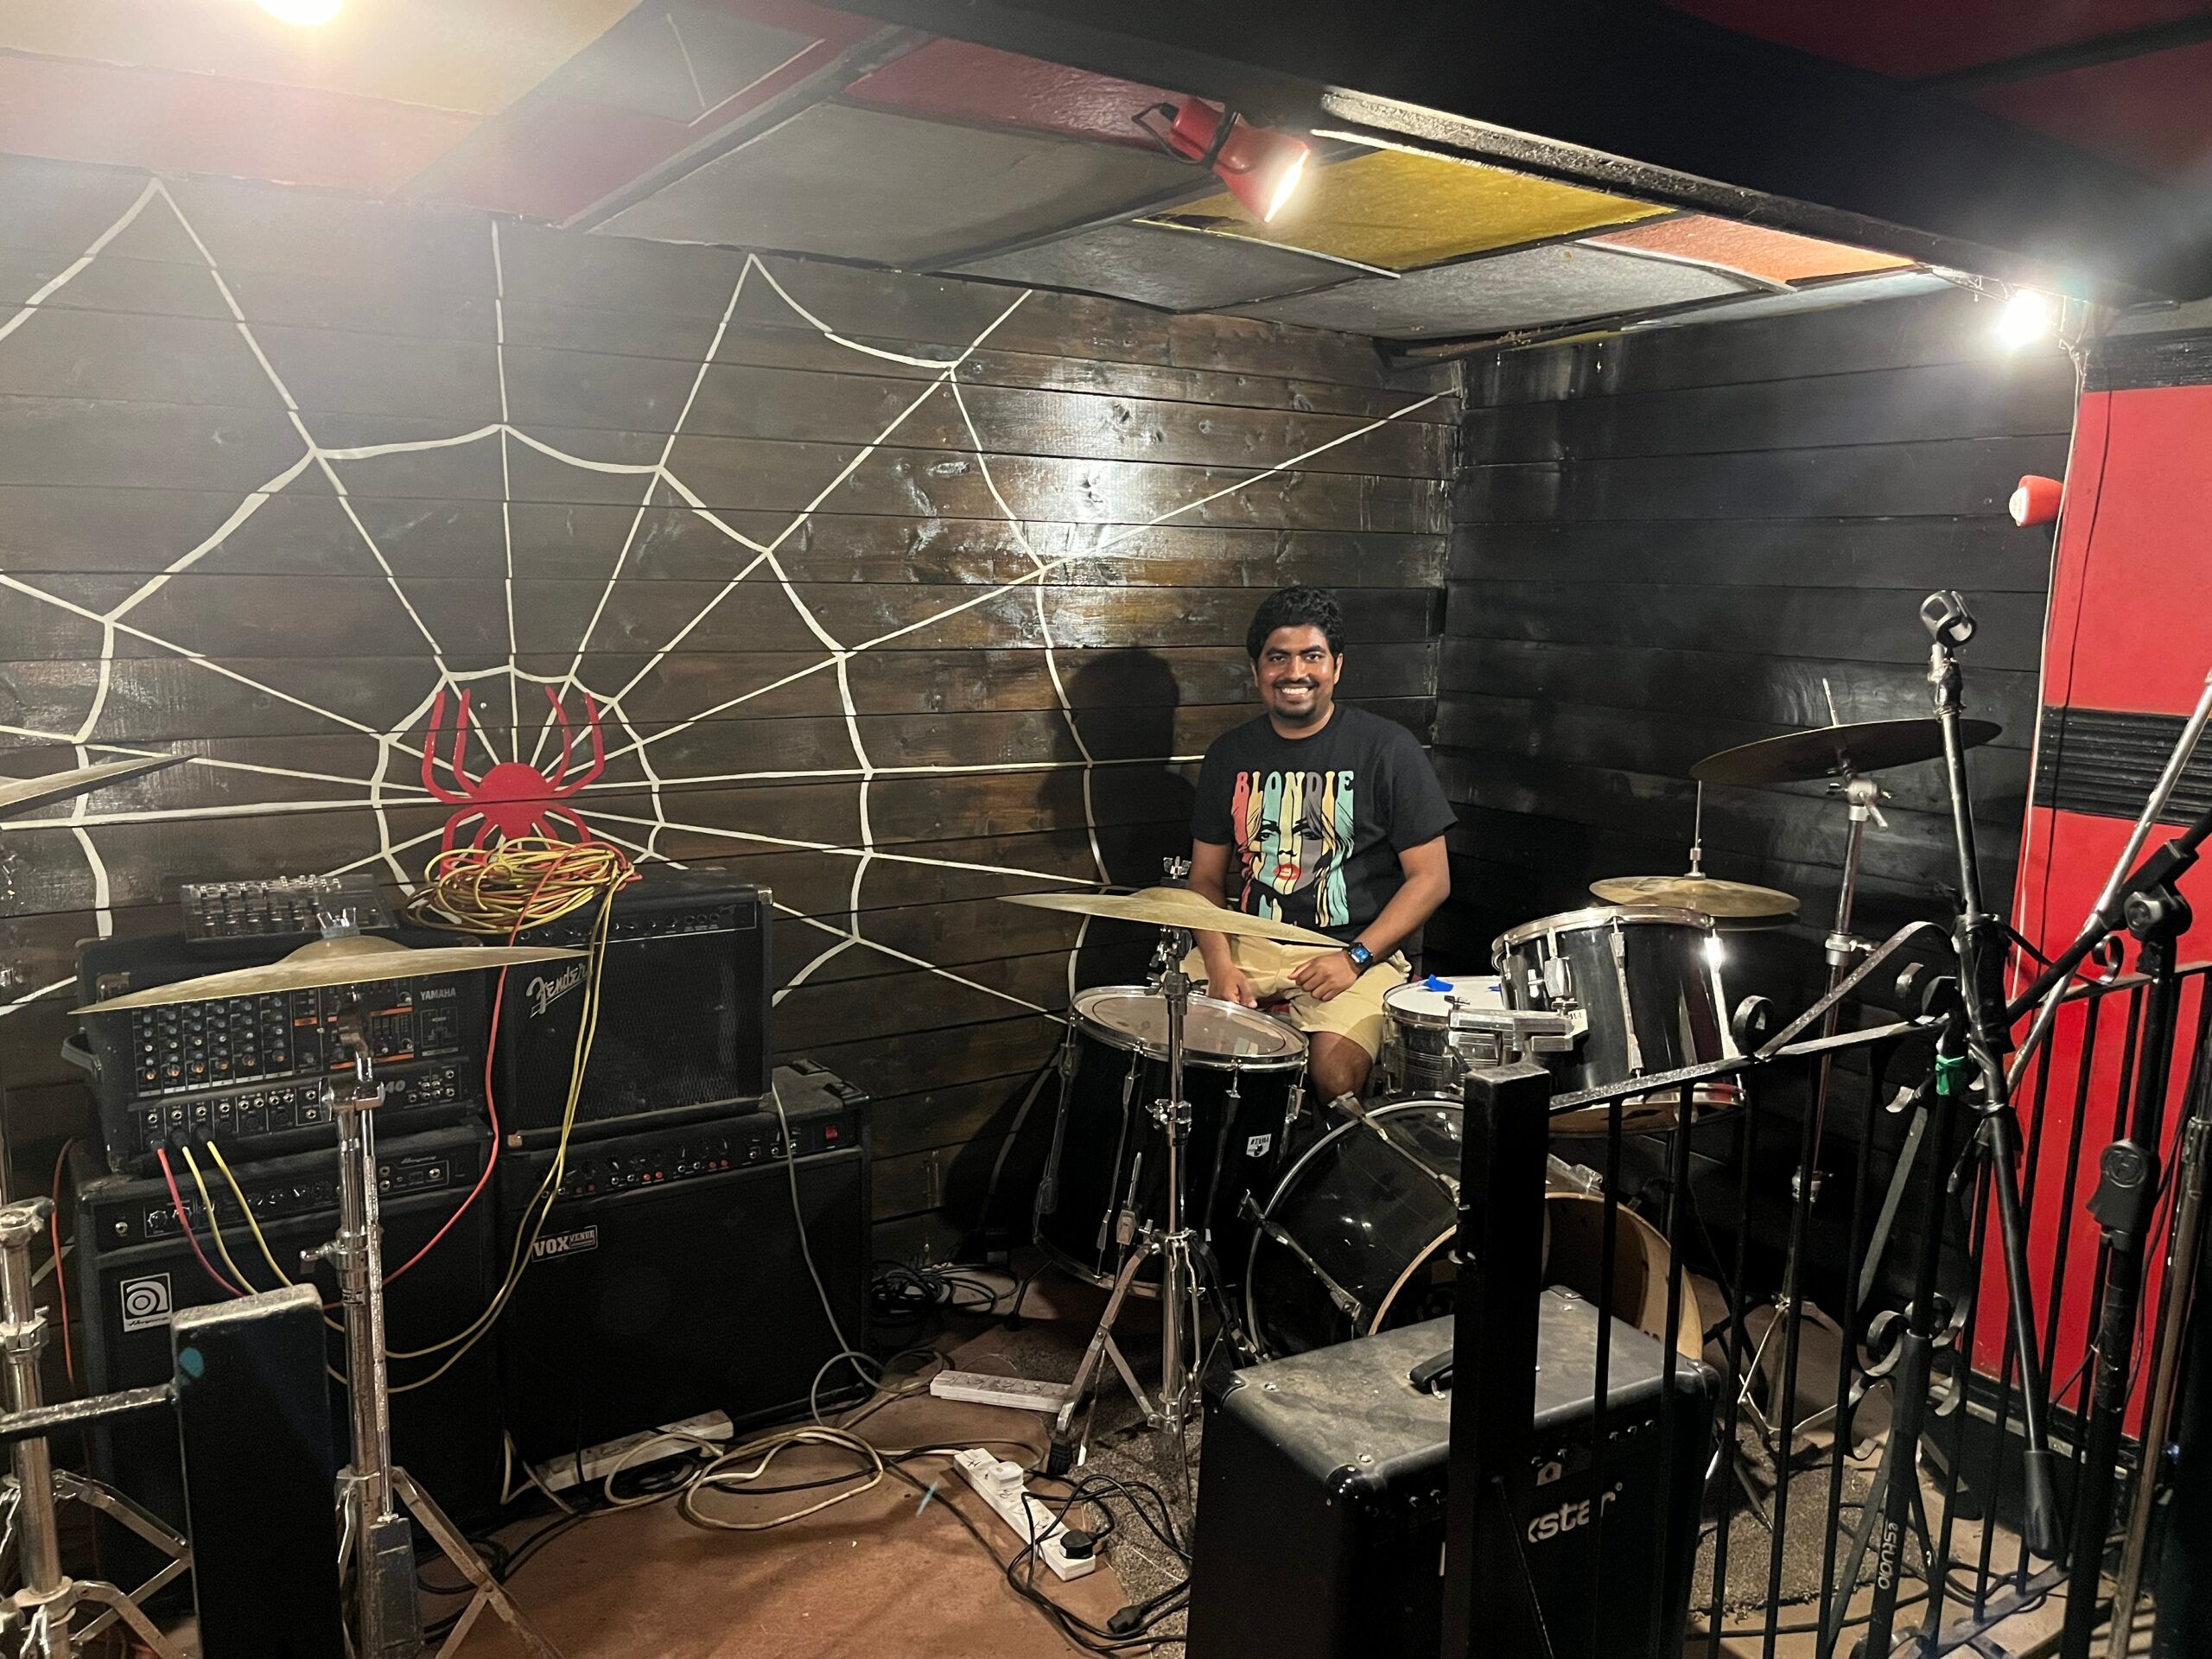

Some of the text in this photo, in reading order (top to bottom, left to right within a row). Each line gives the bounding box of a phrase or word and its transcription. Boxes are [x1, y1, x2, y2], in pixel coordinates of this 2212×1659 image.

[420, 987, 456, 1001] YAMAHA
[525, 963, 587, 1014] Fender
[533, 1236, 570, 1256] VOX
